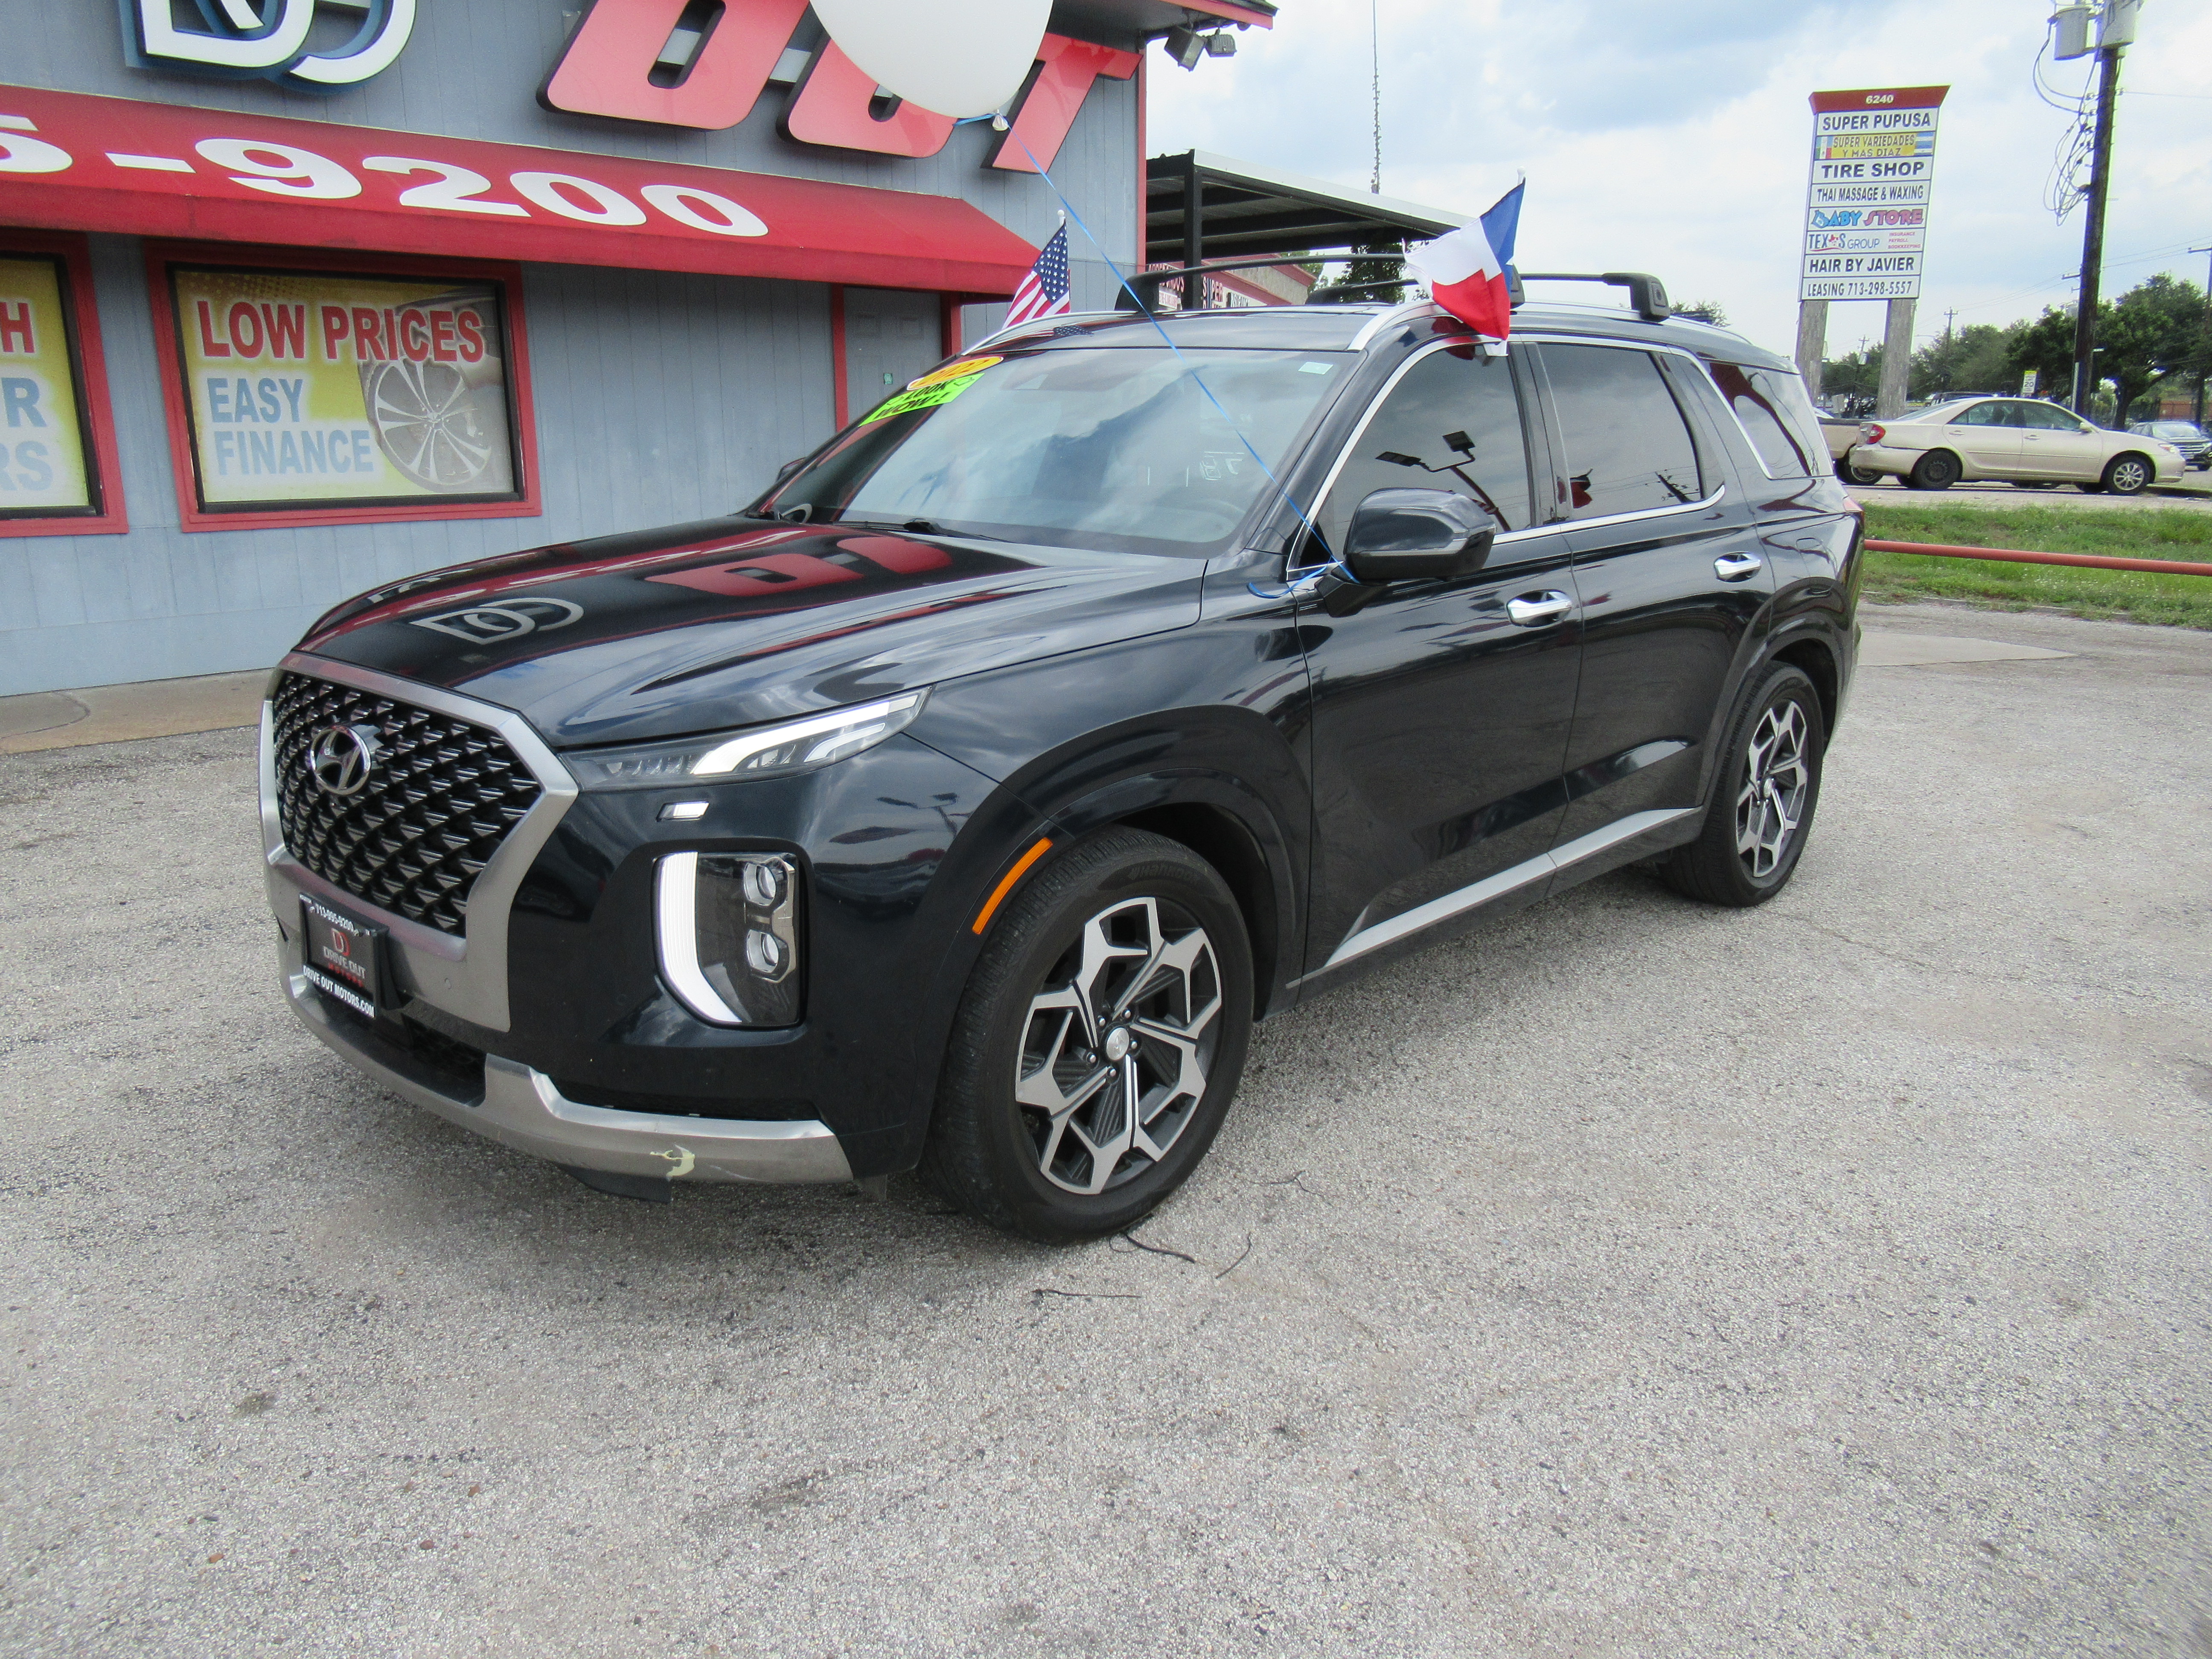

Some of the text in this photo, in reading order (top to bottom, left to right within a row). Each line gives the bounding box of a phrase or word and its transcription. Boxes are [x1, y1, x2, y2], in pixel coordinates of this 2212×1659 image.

[1866, 95, 1894, 104] 6240
[1822, 113, 1931, 131] SUPER PUPUSA
[1833, 134, 1915, 148] SUPER VARIEDADES
[1842, 148, 1901, 157] Y MAS DIAZ
[1822, 162, 1925, 178] TIRE SHOP
[1817, 185, 1924, 202] THAI MASSAGE & WAXING
[1863, 209, 1924, 226] STORE
[1847, 239, 1880, 249] GROUP
[1810, 257, 1914, 273] HAIR BY JAVIER
[1807, 280, 1912, 297] LEASING 713-298-5557
[197, 300, 485, 363] LOW PRICES
[207, 377, 304, 424] EASY
[214, 429, 374, 476] FINANCE
[323, 946, 366, 979] DRIVE OUT
[303, 965, 375, 1018] DRIVE OUT MOTORS.COM
